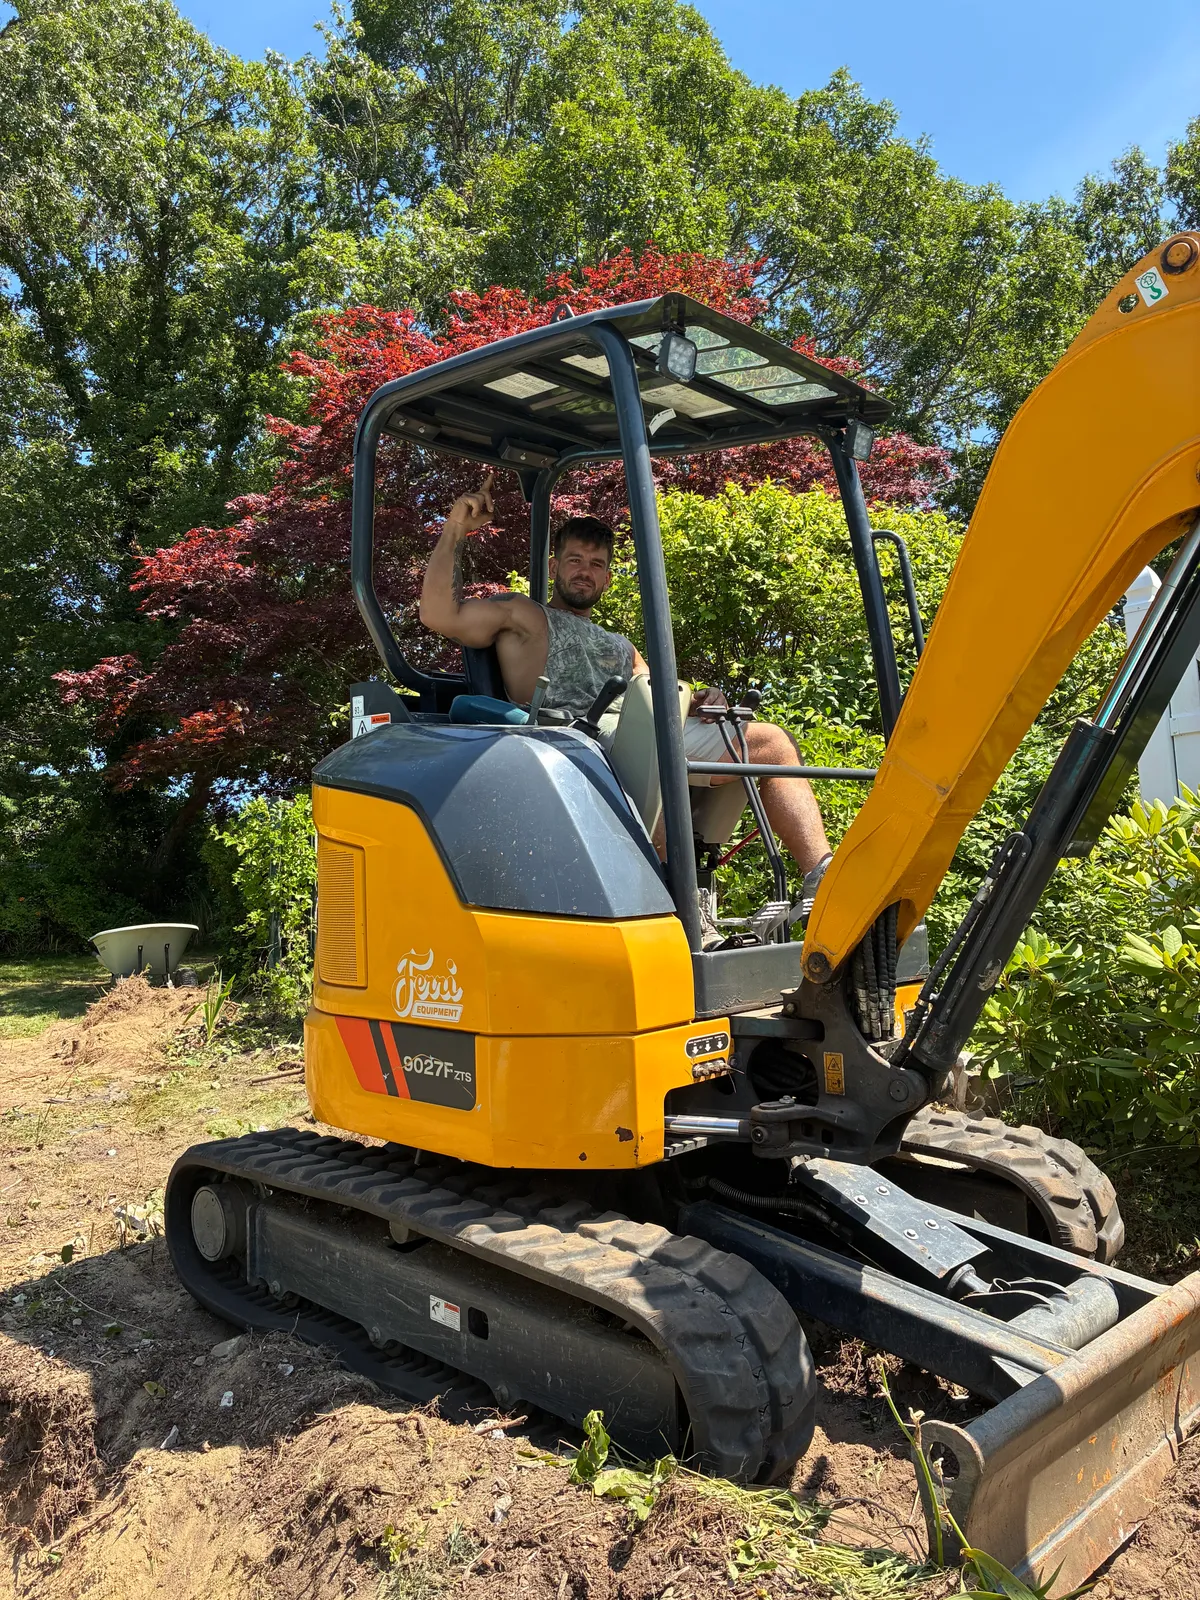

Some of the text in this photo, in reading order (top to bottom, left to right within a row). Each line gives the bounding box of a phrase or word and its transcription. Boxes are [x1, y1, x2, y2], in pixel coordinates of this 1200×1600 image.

[391, 948, 463, 1017] Ferri
[416, 1005, 459, 1018] EQUIPMENT
[403, 1055, 472, 1083] 9027F ZTS
